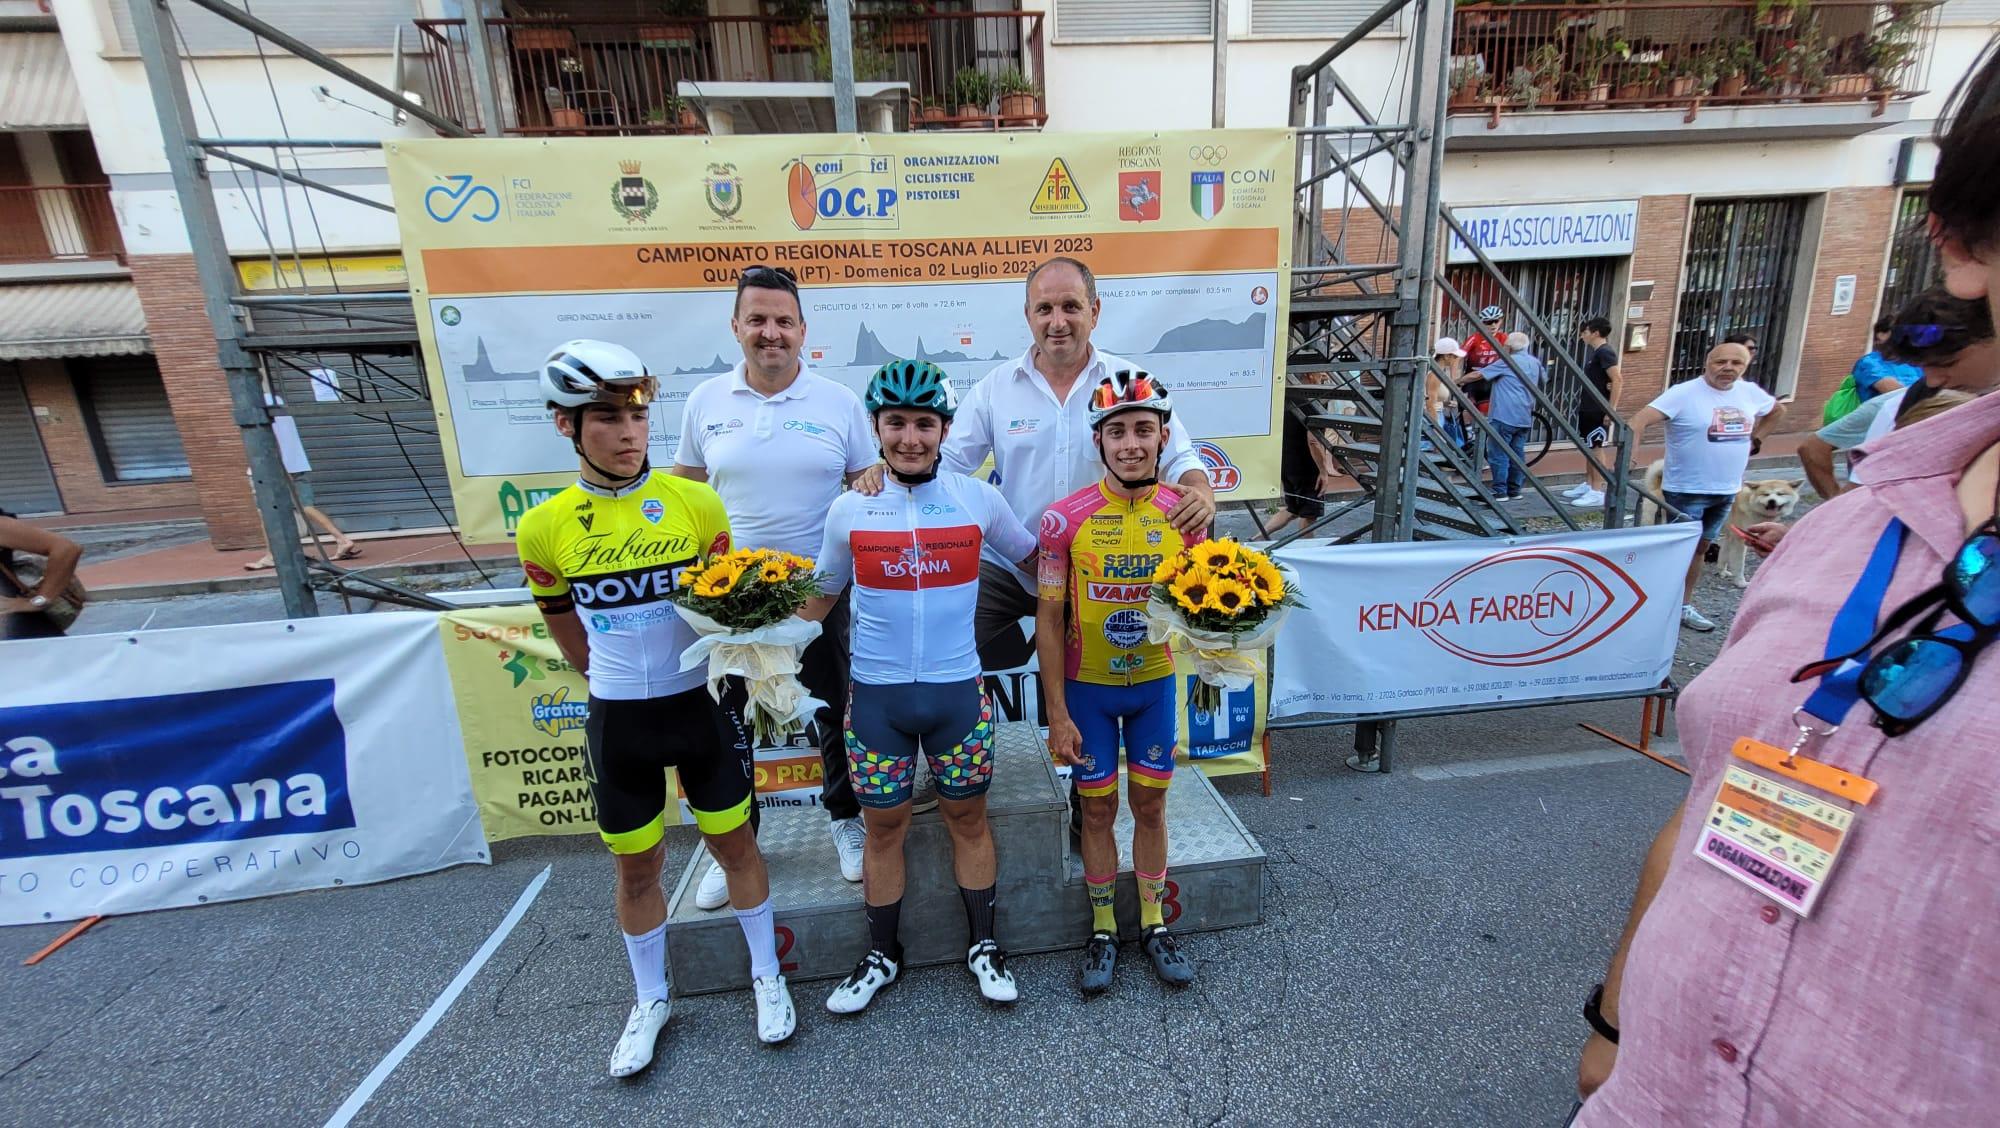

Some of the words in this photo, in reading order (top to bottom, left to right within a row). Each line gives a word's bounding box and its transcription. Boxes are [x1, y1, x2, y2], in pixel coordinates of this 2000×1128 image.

[1118, 146, 1161, 157] REGIONE
[814, 158, 844, 174] coni
[869, 157, 888, 174] fci
[903, 155, 1000, 167] ORGANIZZAZIONI
[1118, 158, 1161, 169] TOSCANA
[904, 172, 975, 184] CICLISTICHE
[1192, 173, 1223, 184] ITALIA
[1230, 168, 1276, 184] CONI
[511, 178, 532, 190] FCI
[514, 191, 573, 201] FEDERAZIONE
[905, 189, 961, 201] PISTOIESI
[1232, 187, 1265, 195] COMITATO
[515, 200, 562, 209] CICLISTICA
[516, 209, 557, 218] ITALIANA
[1453, 218, 1499, 250] MARI
[1500, 213, 1633, 247] ASSICURAZIONI
[636, 245, 769, 264] CAMPIONATO
[775, 243, 883, 261] REGIONALE
[887, 241, 977, 259] TOSCANA
[982, 239, 1048, 256] ALLIEVI
[1053, 237, 1094, 253] 2023
[800, 265, 831, 282] (PT)
[844, 264, 922, 280] Domenica
[928, 263, 946, 277] 02
[951, 261, 998, 279] Luglio
[1002, 259, 1036, 275] 2023
[1137, 289, 1148, 297] km
[1151, 289, 1162, 297] per
[1165, 287, 1201, 297] complessivi
[1221, 286, 1232, 294] km
[813, 303, 851, 312] CIRCUITO
[877, 302, 889, 310] km
[891, 303, 903, 312] per
[956, 299, 967, 308] km
[557, 313, 579, 322] GIRO
[580, 312, 614, 321] INIZIALE
[640, 311, 653, 320] km
[1229, 369, 1239, 377] km
[857, 544, 901, 554] CAMPIONE
[925, 539, 974, 550] REGIONALE
[565, 527, 692, 575] Fabiani
[1358, 599, 1460, 634] KENDA
[1468, 590, 1575, 625] FARBEN
[1331, 692, 1341, 702] Via
[533, 704, 587, 719] Gratta
[1195, 739, 1247, 756] TABACCHI
[0, 772, 328, 841] Toscana
[755, 795, 802, 809] ellina
[69, 839, 362, 889] COOPERATIVO
[1707, 837, 1809, 901] ORGANIZZAZIONE
